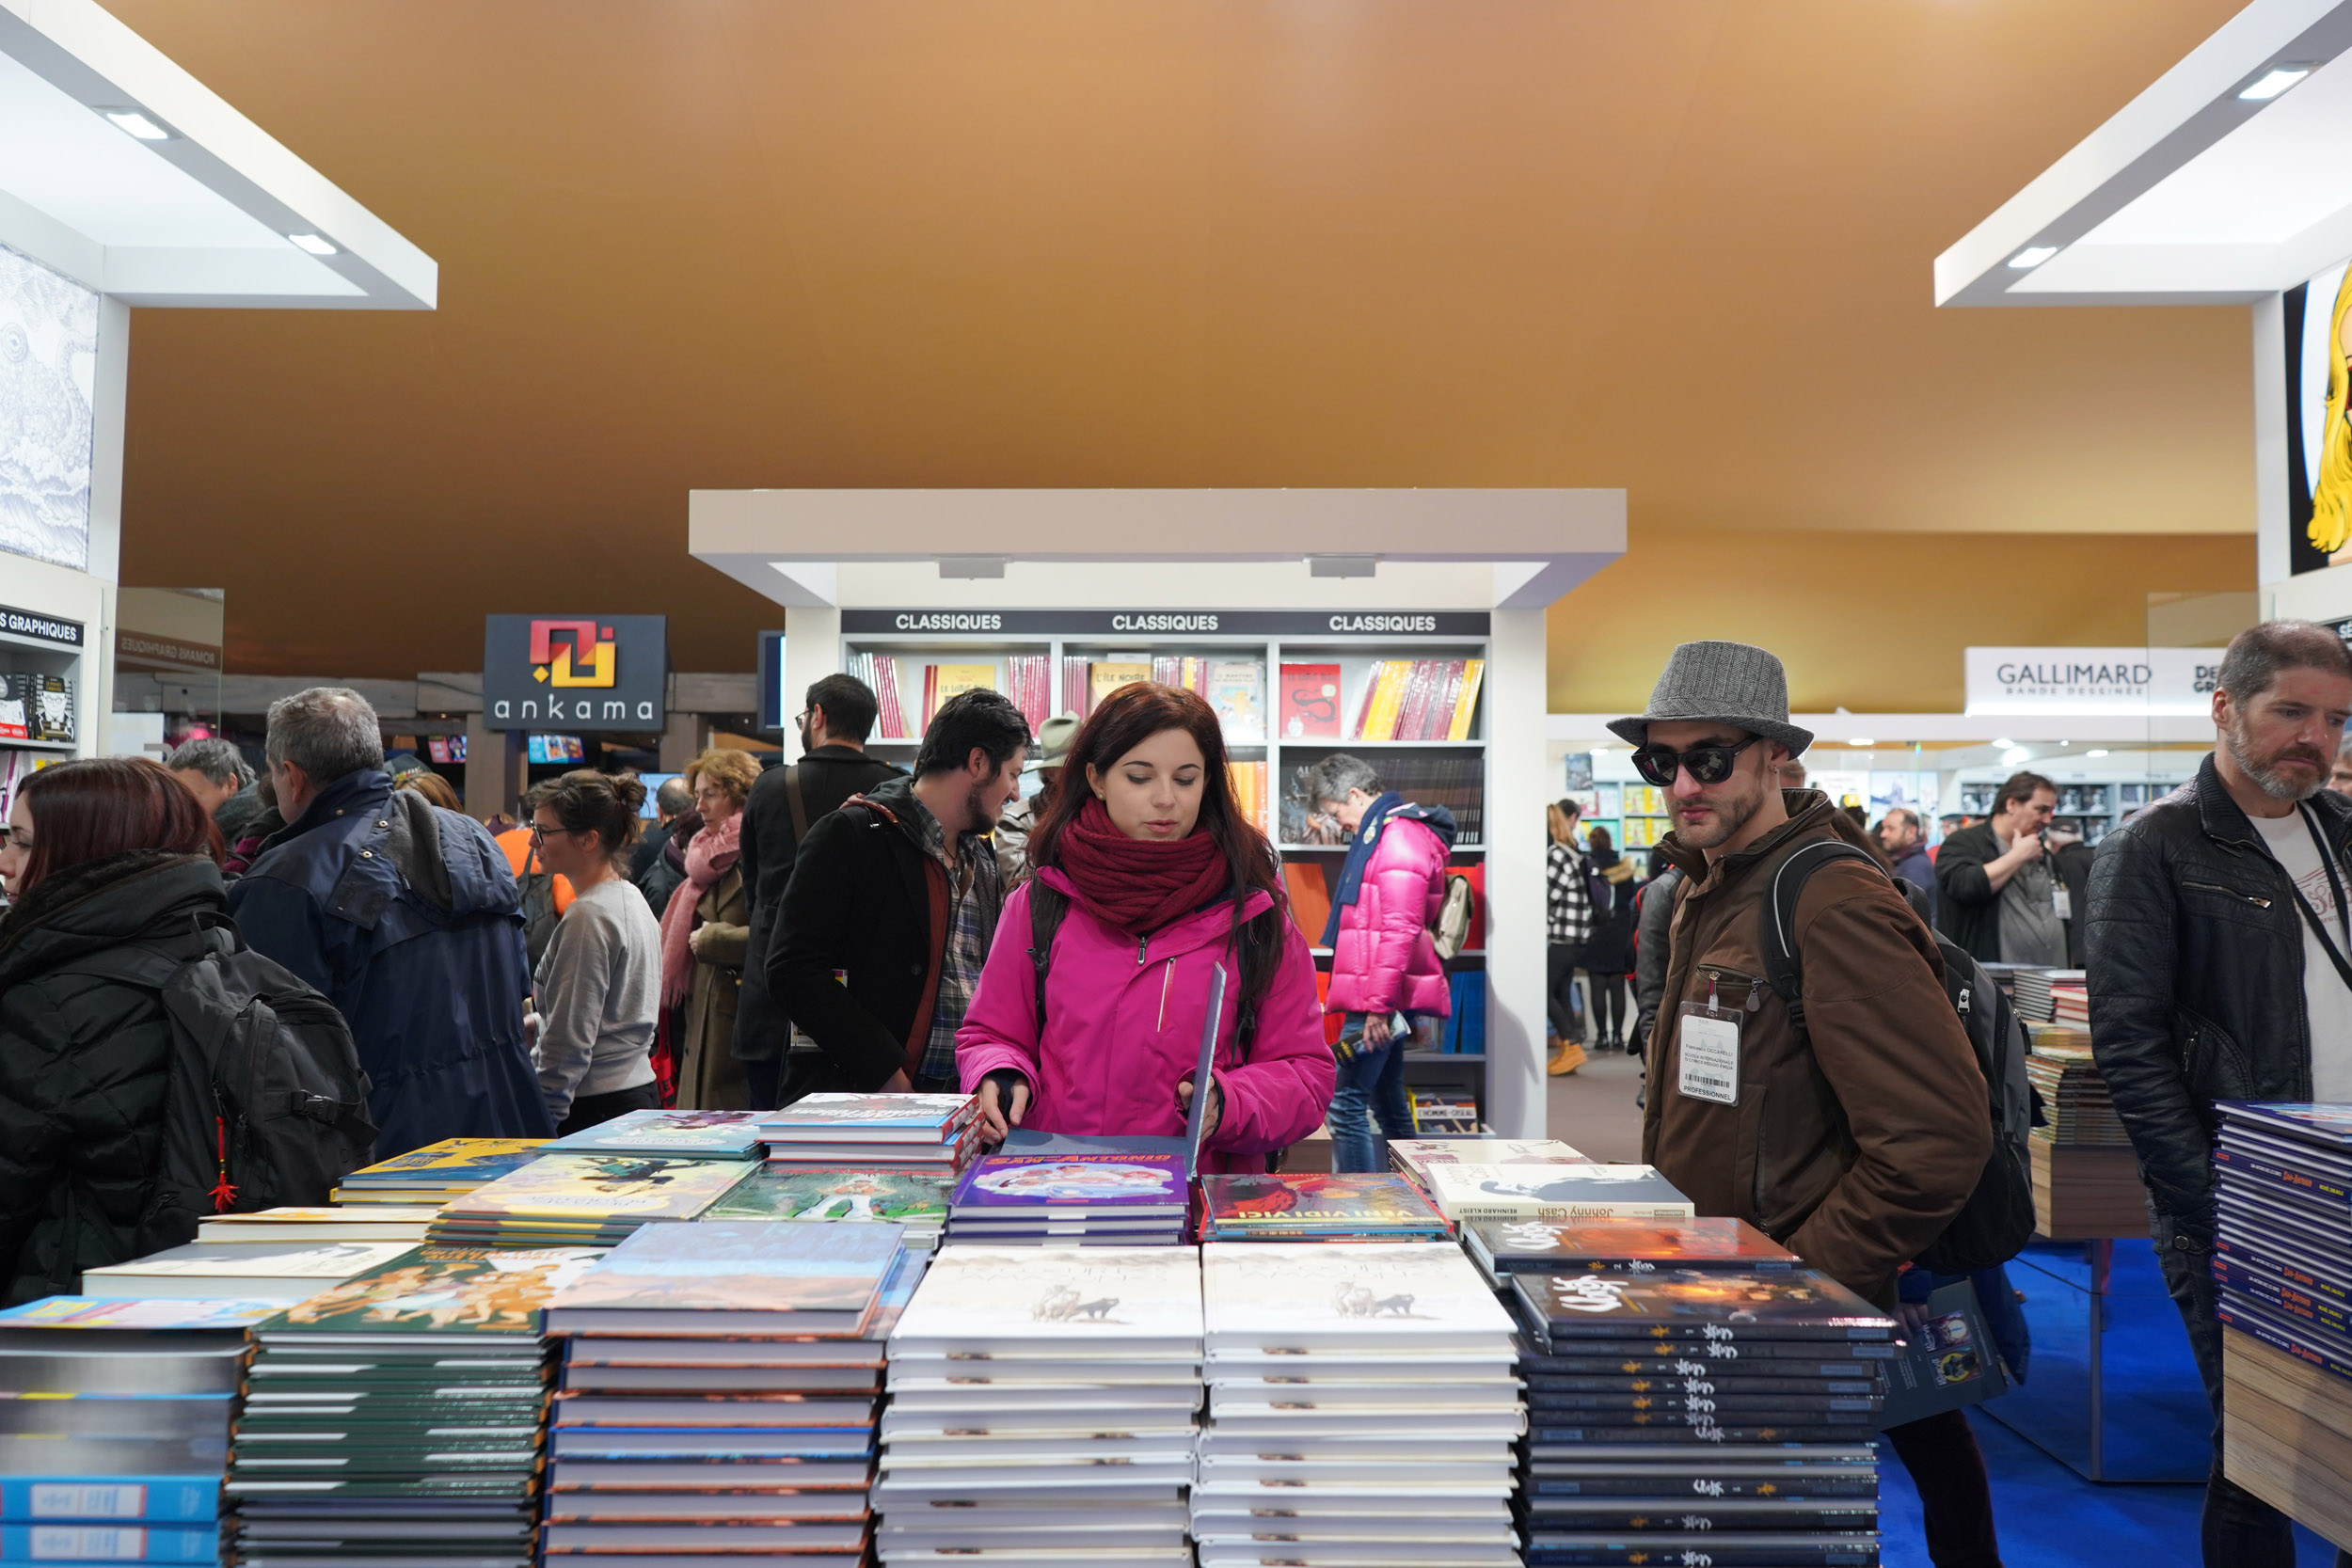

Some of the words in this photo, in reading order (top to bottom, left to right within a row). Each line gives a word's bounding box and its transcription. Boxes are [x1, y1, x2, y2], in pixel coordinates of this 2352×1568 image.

[8, 614, 77, 641] GRAPHIQUES
[896, 614, 1002, 630] CLASSIQUES
[1112, 615, 1219, 631] CLASSIQUES
[1328, 616, 1437, 631] CLASSIQUES
[1119, 673, 1145, 682] NOIRE
[1996, 664, 2153, 685] GALLIMARD
[2195, 666, 2221, 679] DE
[2067, 686, 2144, 695] DESSINÉE
[2193, 681, 2216, 693] GR
[494, 694, 654, 720] ankama
[1683, 1085, 1732, 1101] PROFESSIONNEL
[986, 1154, 1171, 1165] SAN-ANTONIO
[1538, 1206, 1565, 1216] Cash
[1569, 1206, 1613, 1216] Johnny
